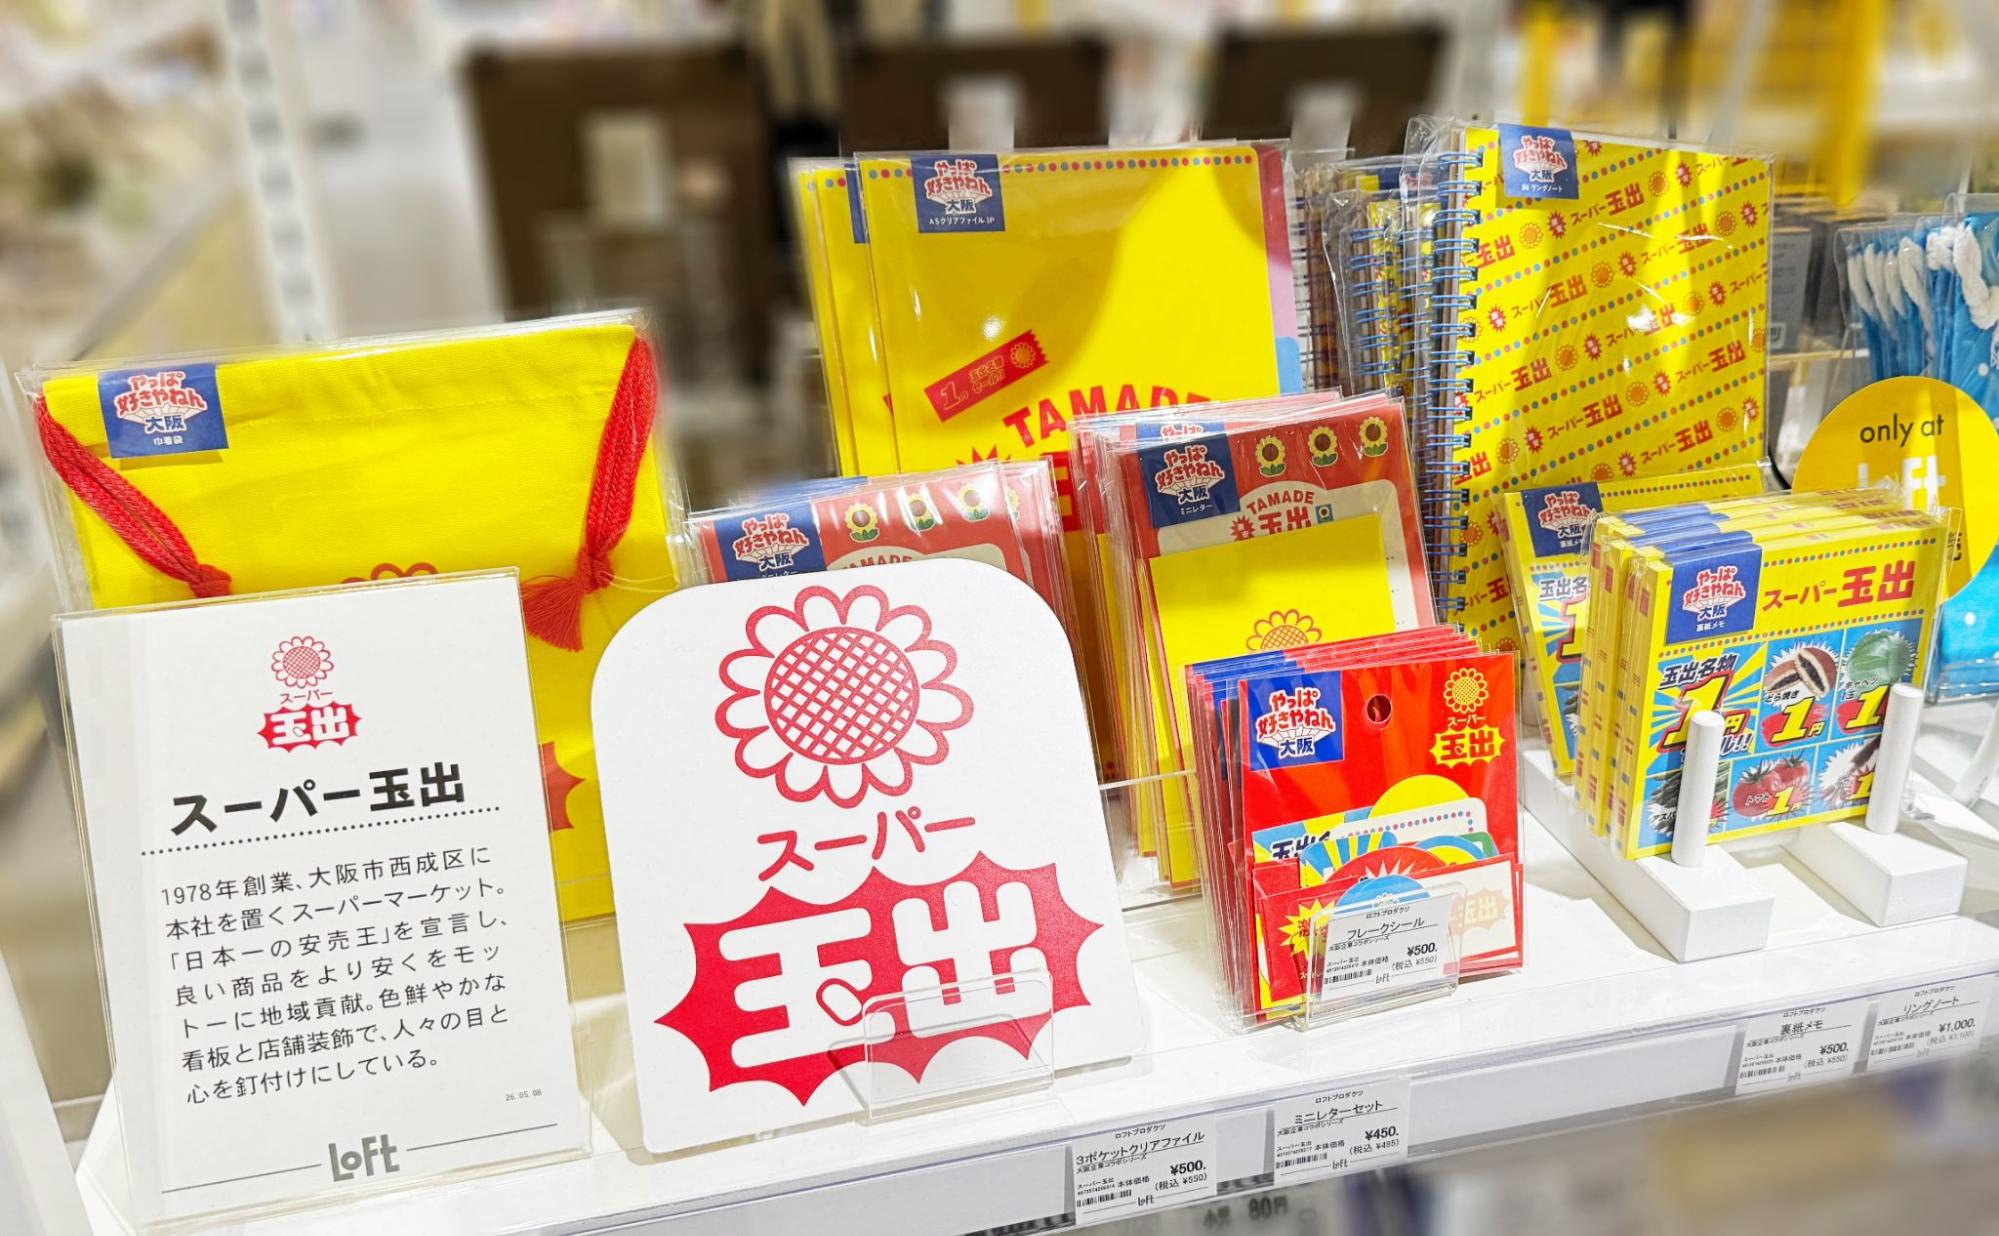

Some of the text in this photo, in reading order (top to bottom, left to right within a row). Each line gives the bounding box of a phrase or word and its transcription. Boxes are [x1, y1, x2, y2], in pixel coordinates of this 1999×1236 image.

[1522, 136, 1554, 149] やっぱ
[935, 160, 977, 177] やっぱ
[1514, 149, 1567, 168] 好きやねん
[926, 176, 991, 197] 好きやねん
[1530, 170, 1553, 182] 大阪
[946, 199, 976, 213] 大阪
[129, 372, 185, 391] やっぱ
[115, 388, 206, 417] 好きやねん
[145, 415, 186, 432] 大阪
[1003, 384, 1211, 448] TAMAD
[1860, 413, 1944, 447] only at
[1165, 446, 1207, 466] やっぱ
[1157, 461, 1224, 489] 好きやねん
[1178, 486, 1209, 503] 大阪
[1246, 490, 1314, 514] TAMADE
[1546, 492, 1579, 508] やっぱ
[743, 514, 788, 534] やっぱ
[734, 529, 808, 557] 好きやねん
[760, 552, 792, 570] 大阪
[1698, 566, 1737, 583] やっぱ
[1762, 560, 1916, 612] スーパー玉出
[1684, 582, 1746, 606] 好きやねん
[1698, 605, 1728, 621] 大阪
[1658, 652, 1739, 690] 玉出名物
[280, 689, 333, 704] スーパー
[1271, 689, 1318, 711] やっぱ
[270, 705, 351, 745] 玉出
[1257, 708, 1334, 739] 好きやねん
[1448, 714, 1486, 727] スーパー
[1280, 737, 1314, 756] 大阪
[1440, 730, 1494, 761] 玉出
[170, 761, 465, 836] スーパー玉出
[757, 806, 976, 882] スーパー
[161, 847, 490, 906] 1978年創業、大阪市西成区に
[166, 877, 504, 941] 本社を置くスーパーマーケット。
[171, 909, 506, 971] 「日本一の安売王」を宣言し、
[1347, 917, 1425, 940] フレークシール
[175, 945, 499, 1007] 良い商品をより安くをモッ
[718, 881, 1038, 1069] 玉出
[183, 972, 505, 1039] トーに地域貢献。色鮮やかな
[1904, 996, 1959, 1014] リングノート
[183, 1004, 508, 1072] 看板と店舗装飾で、人々の目と
[187, 1050, 437, 1105] 心を釘付けにしている。
[1295, 1100, 1383, 1124] ミニレターセット
[1076, 1132, 1205, 1165] 3ポケットクリアファイル
